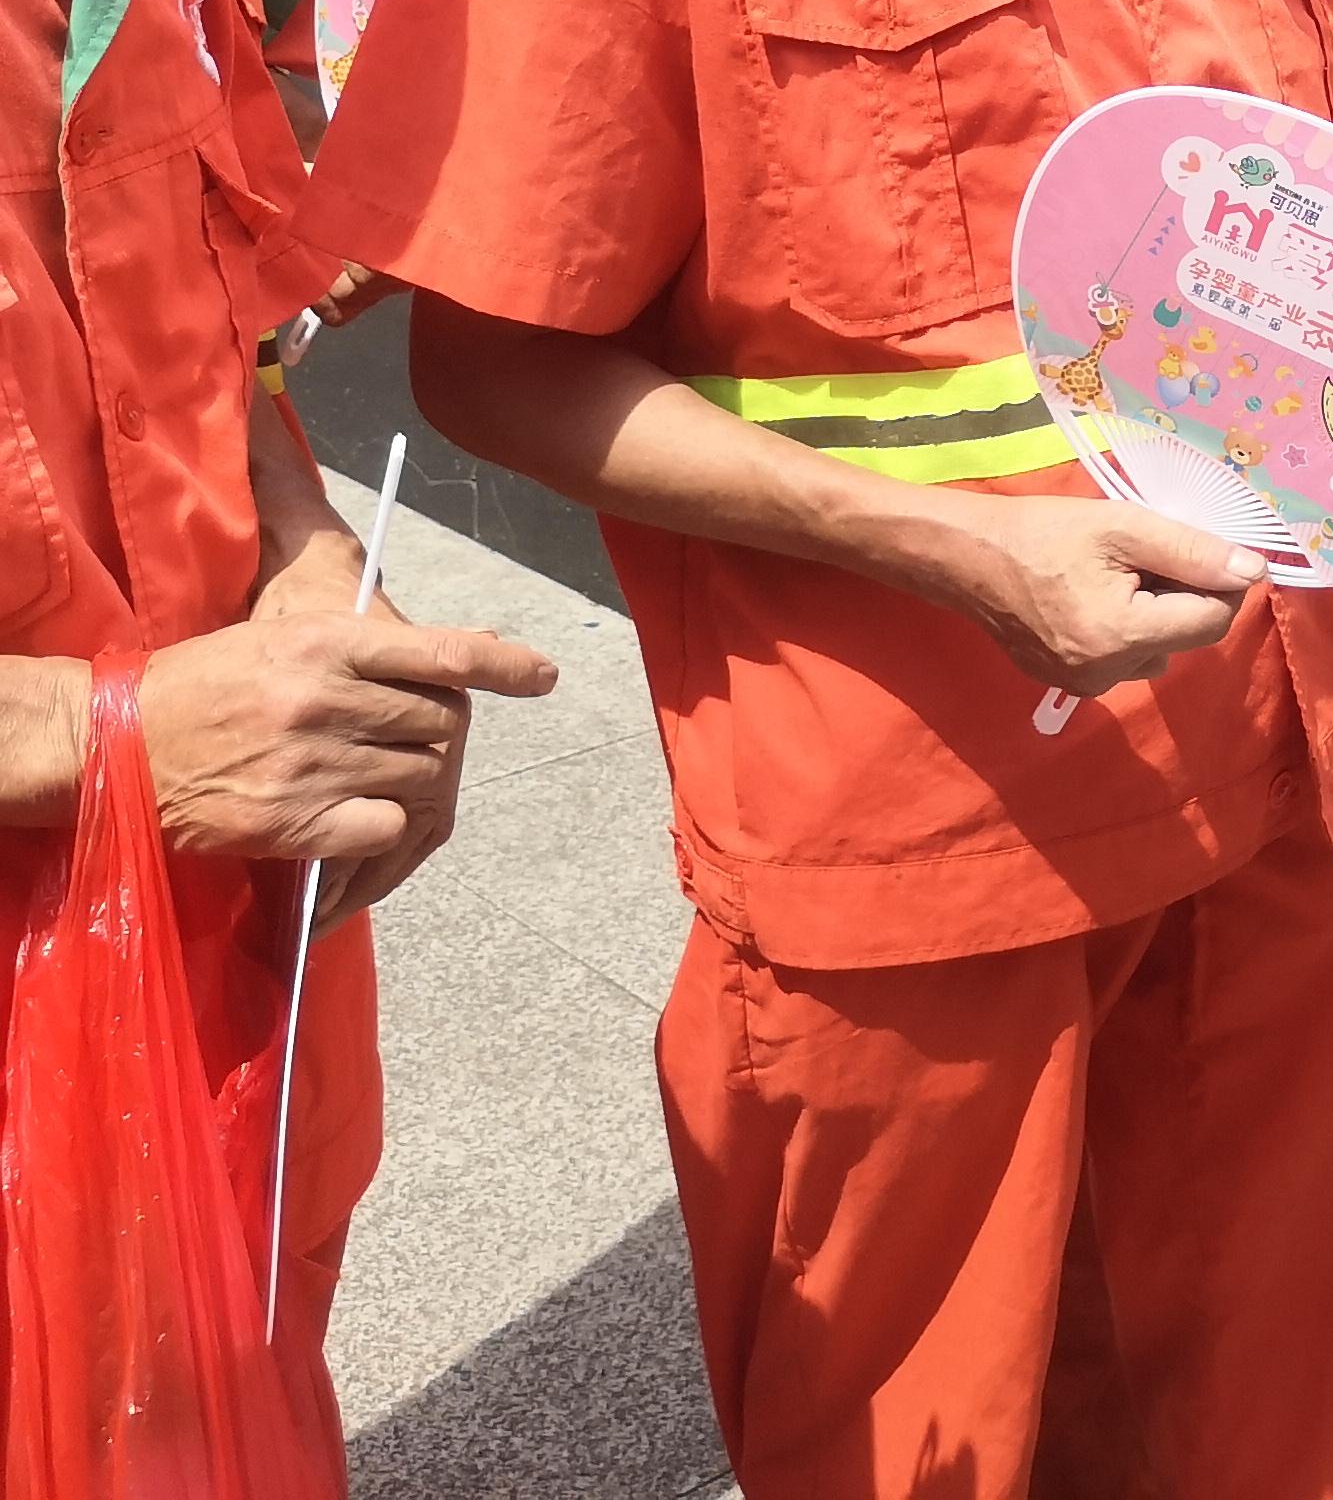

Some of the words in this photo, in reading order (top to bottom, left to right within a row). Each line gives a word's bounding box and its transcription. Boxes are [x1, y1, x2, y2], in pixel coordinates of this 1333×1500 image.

[1270, 191, 1320, 228] 可贝思
[1201, 234, 1258, 263] AIYINGWU
